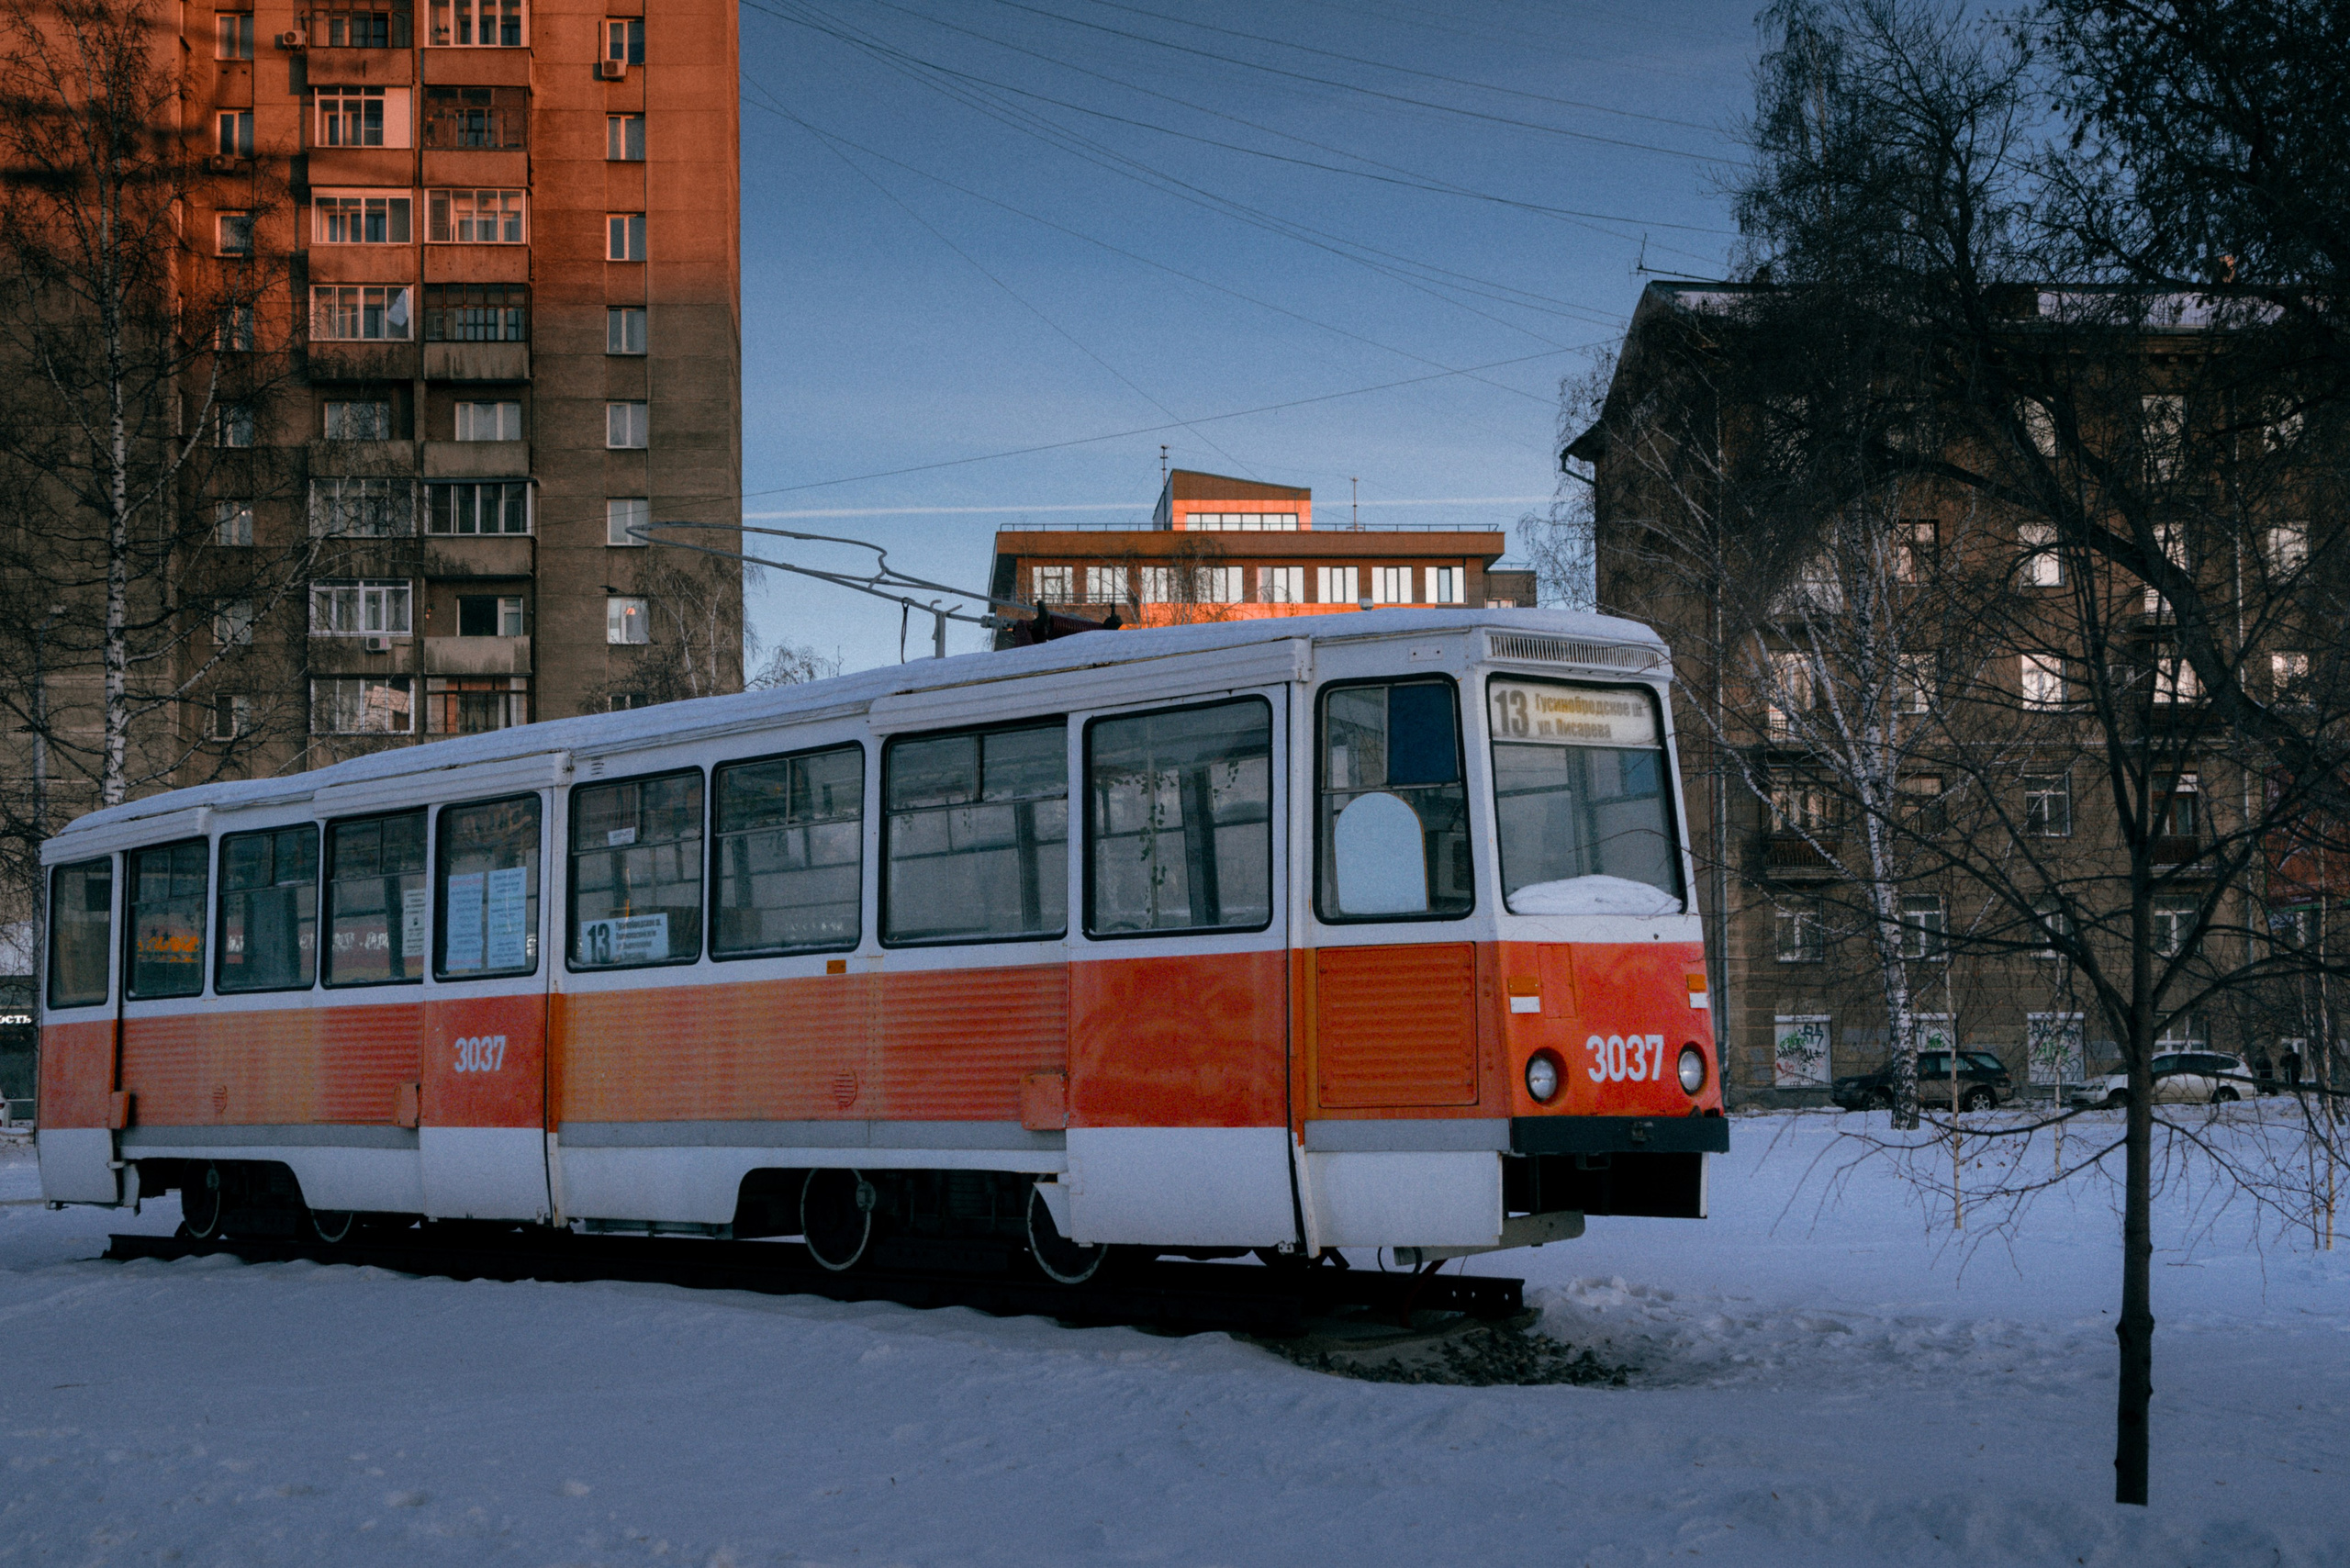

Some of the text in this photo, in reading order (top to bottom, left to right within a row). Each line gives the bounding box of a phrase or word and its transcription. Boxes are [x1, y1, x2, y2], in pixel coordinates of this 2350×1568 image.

[1494, 690, 1529, 737] 13
[1535, 693, 1630, 717] Гусинобродское
[1555, 718, 1612, 739] Писарева
[587, 923, 611, 964] 13
[453, 1035, 507, 1073] 3037
[1585, 1034, 1664, 1083] 3037
